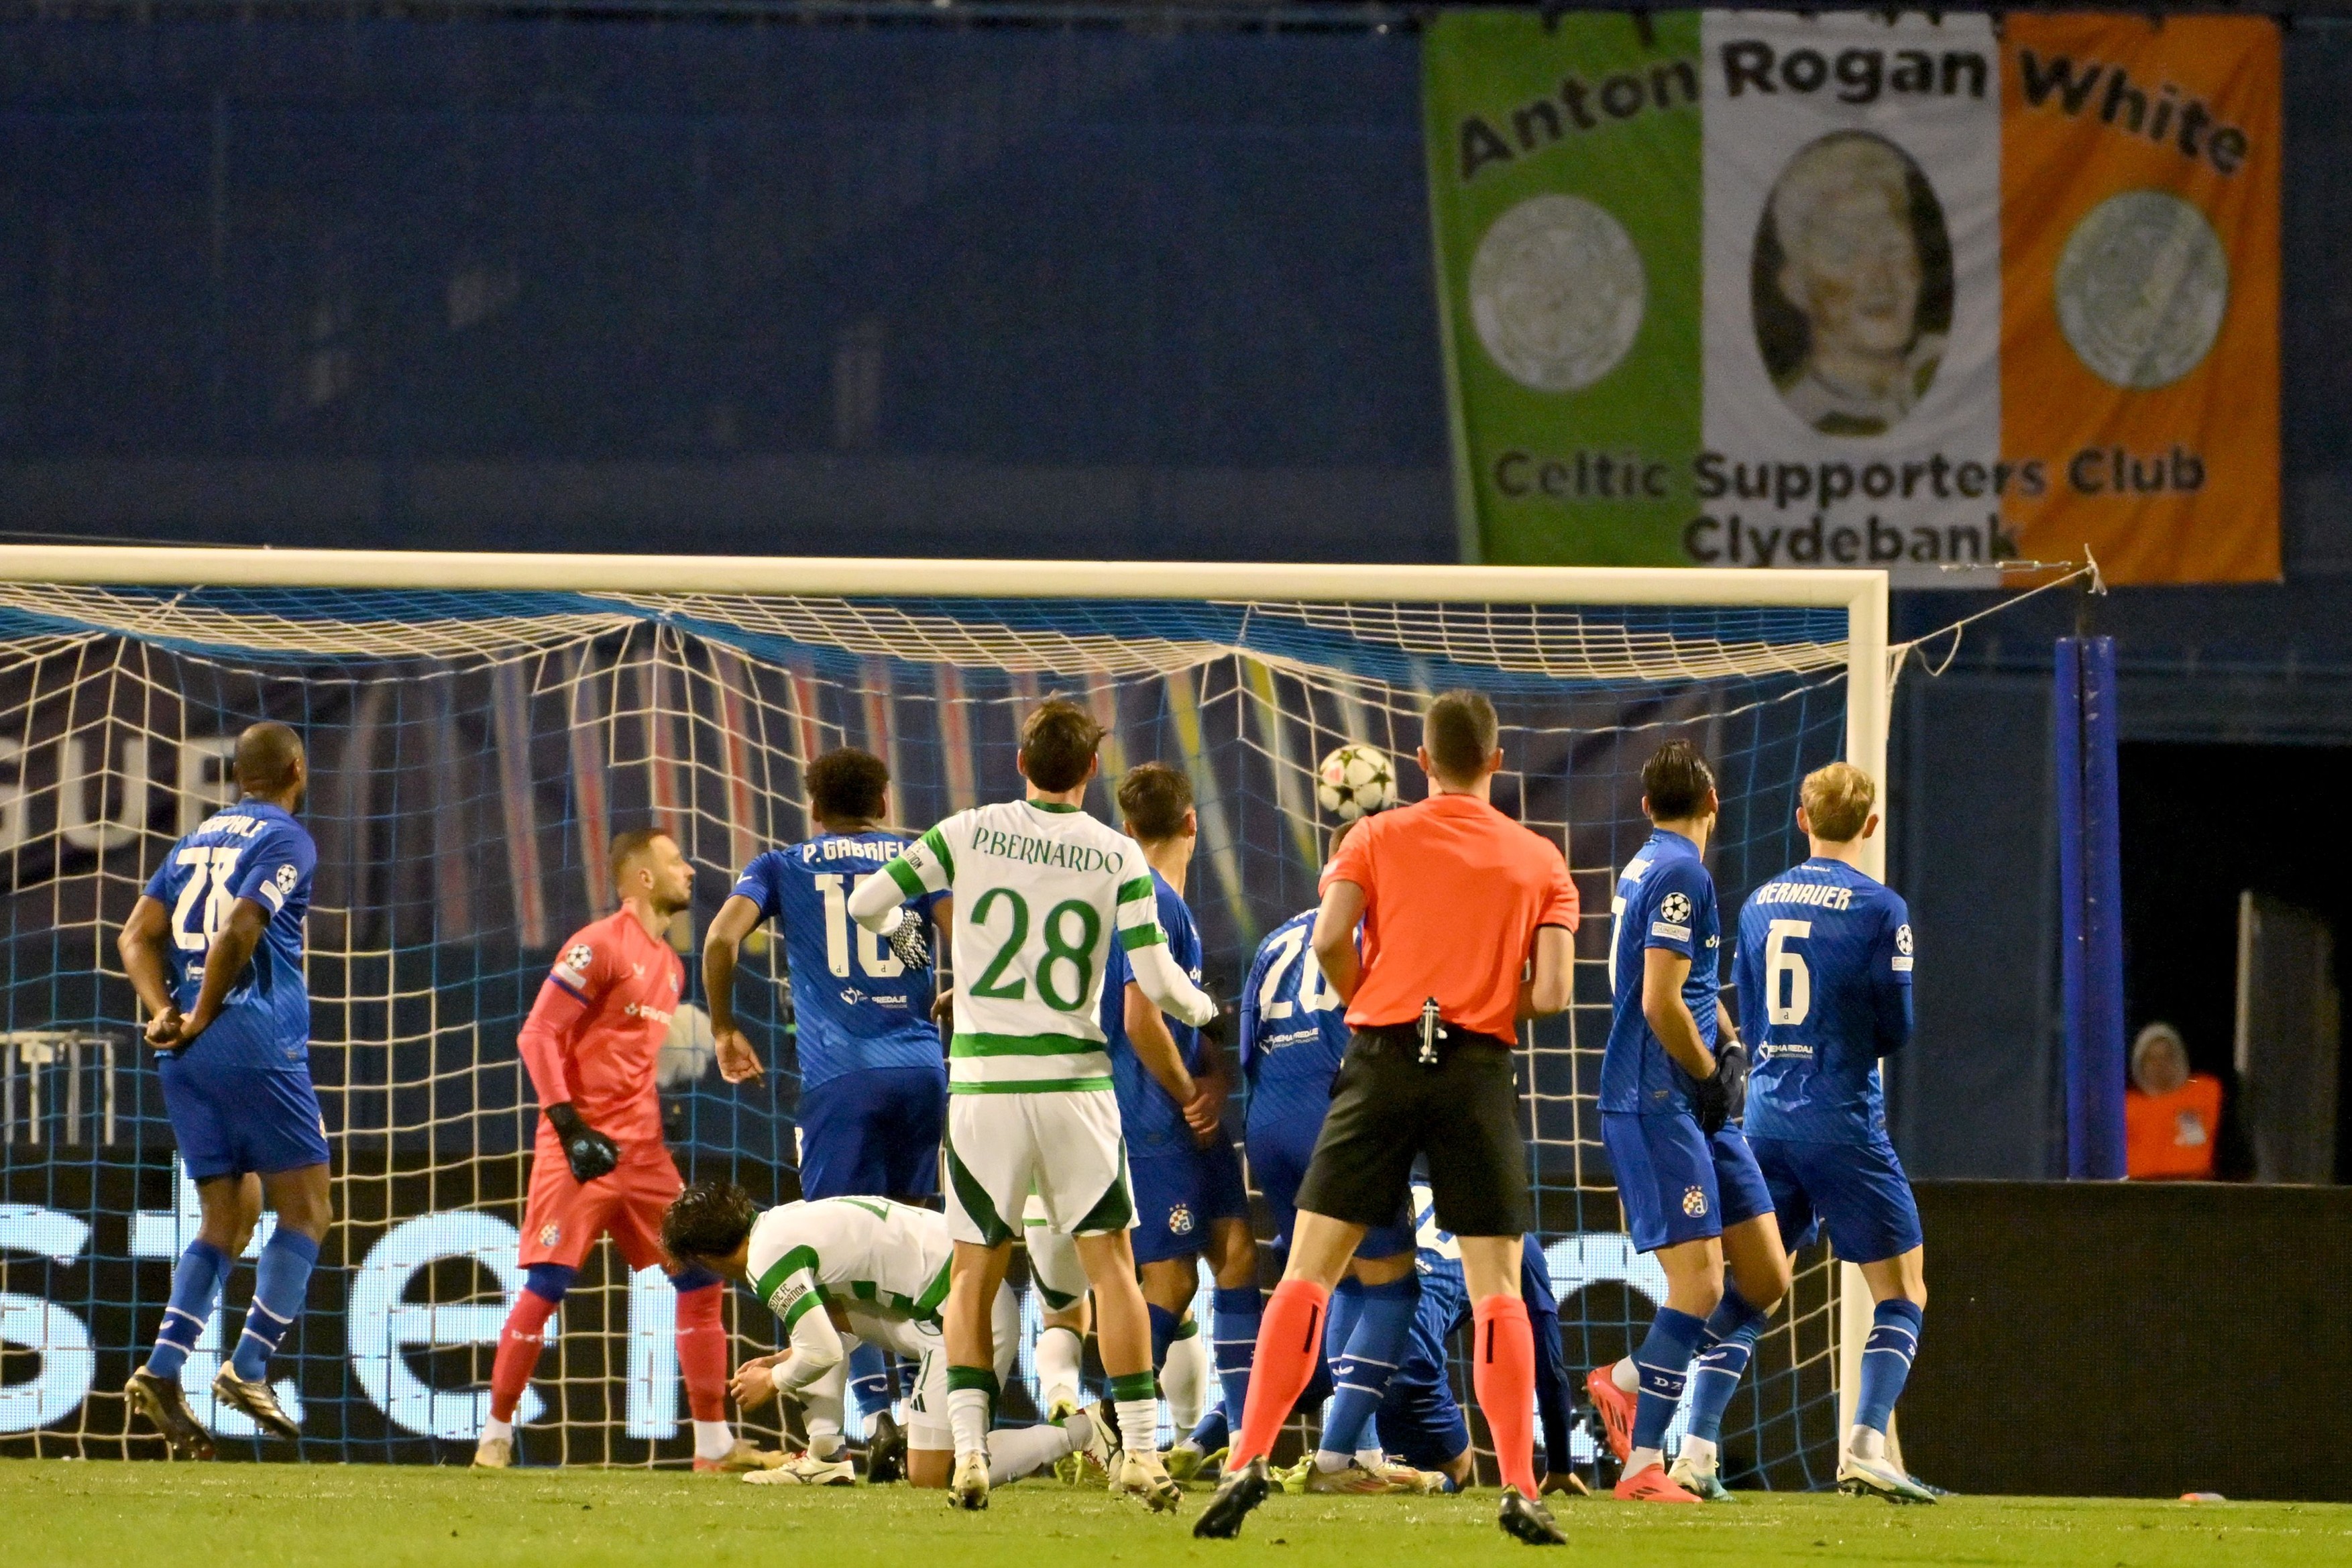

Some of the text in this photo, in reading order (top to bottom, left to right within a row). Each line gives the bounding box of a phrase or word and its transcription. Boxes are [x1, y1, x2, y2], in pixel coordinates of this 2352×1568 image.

[1459, 40, 2250, 183] Anton Rogan White
[1493, 445, 2206, 510] Celtic Supporters Club
[1682, 515, 2021, 567] Clydebank
[823, 838, 905, 862] GABRIEL
[971, 826, 1124, 875] P.BERNARDO
[171, 846, 243, 950] 28
[1756, 882, 1852, 911] BERNAUER
[969, 887, 1102, 1012] 28
[1765, 919, 1811, 1026] 6
[779, 1282, 791, 1296] FC
